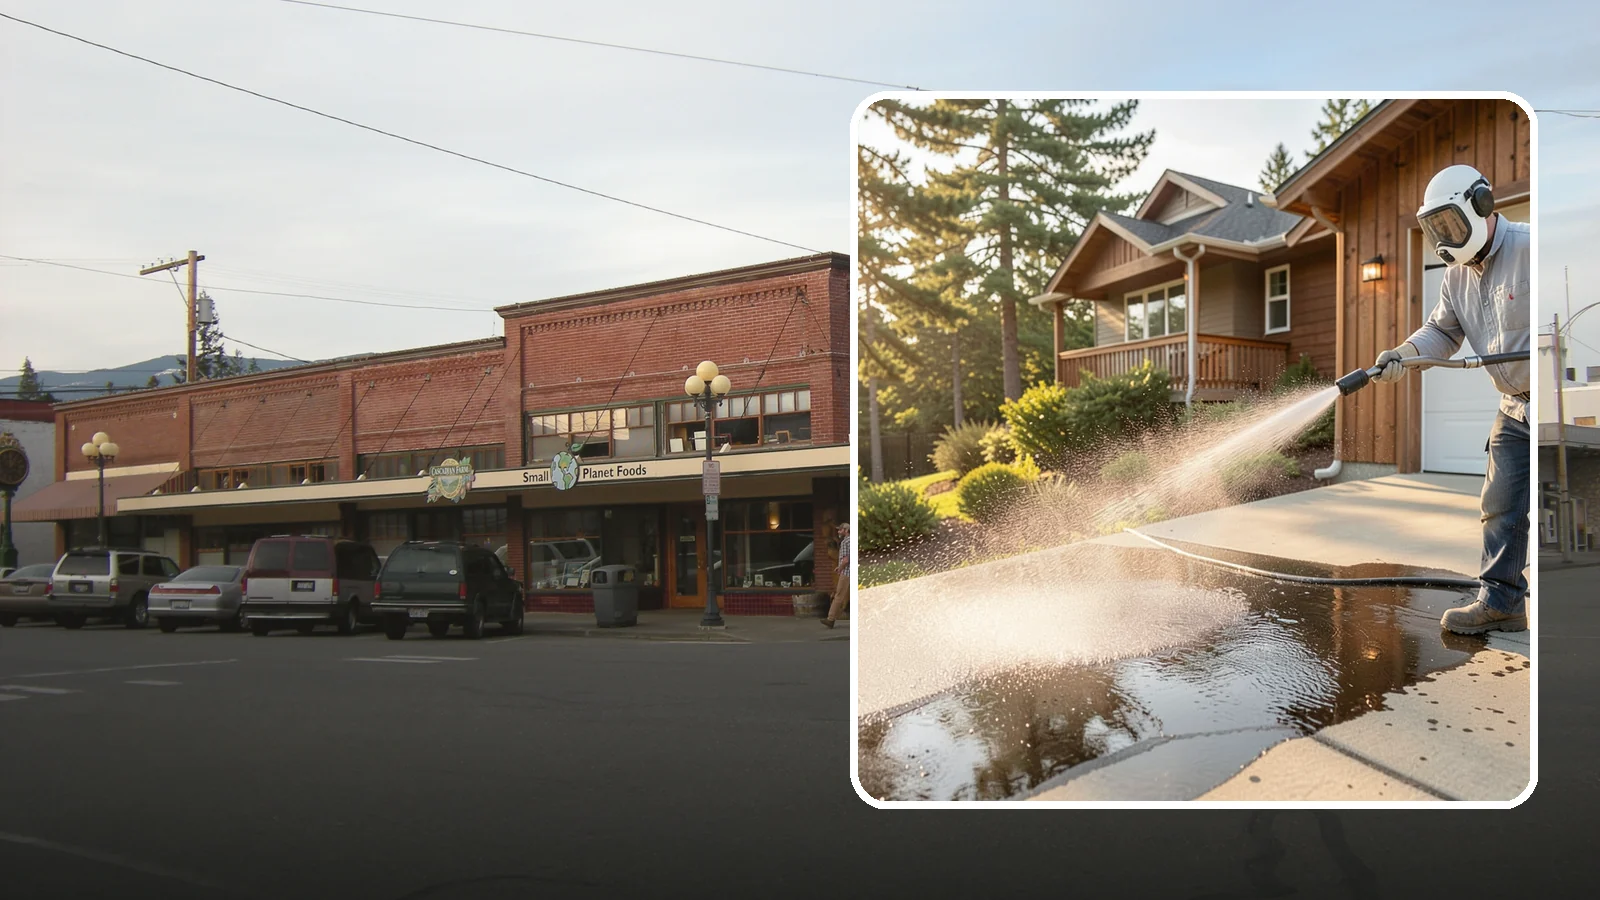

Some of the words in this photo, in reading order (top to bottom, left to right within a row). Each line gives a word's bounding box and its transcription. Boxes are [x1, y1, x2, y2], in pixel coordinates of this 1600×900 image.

[523, 471, 549, 483] Small
[583, 468, 614, 479] Planet
[617, 464, 647, 477] Foods
